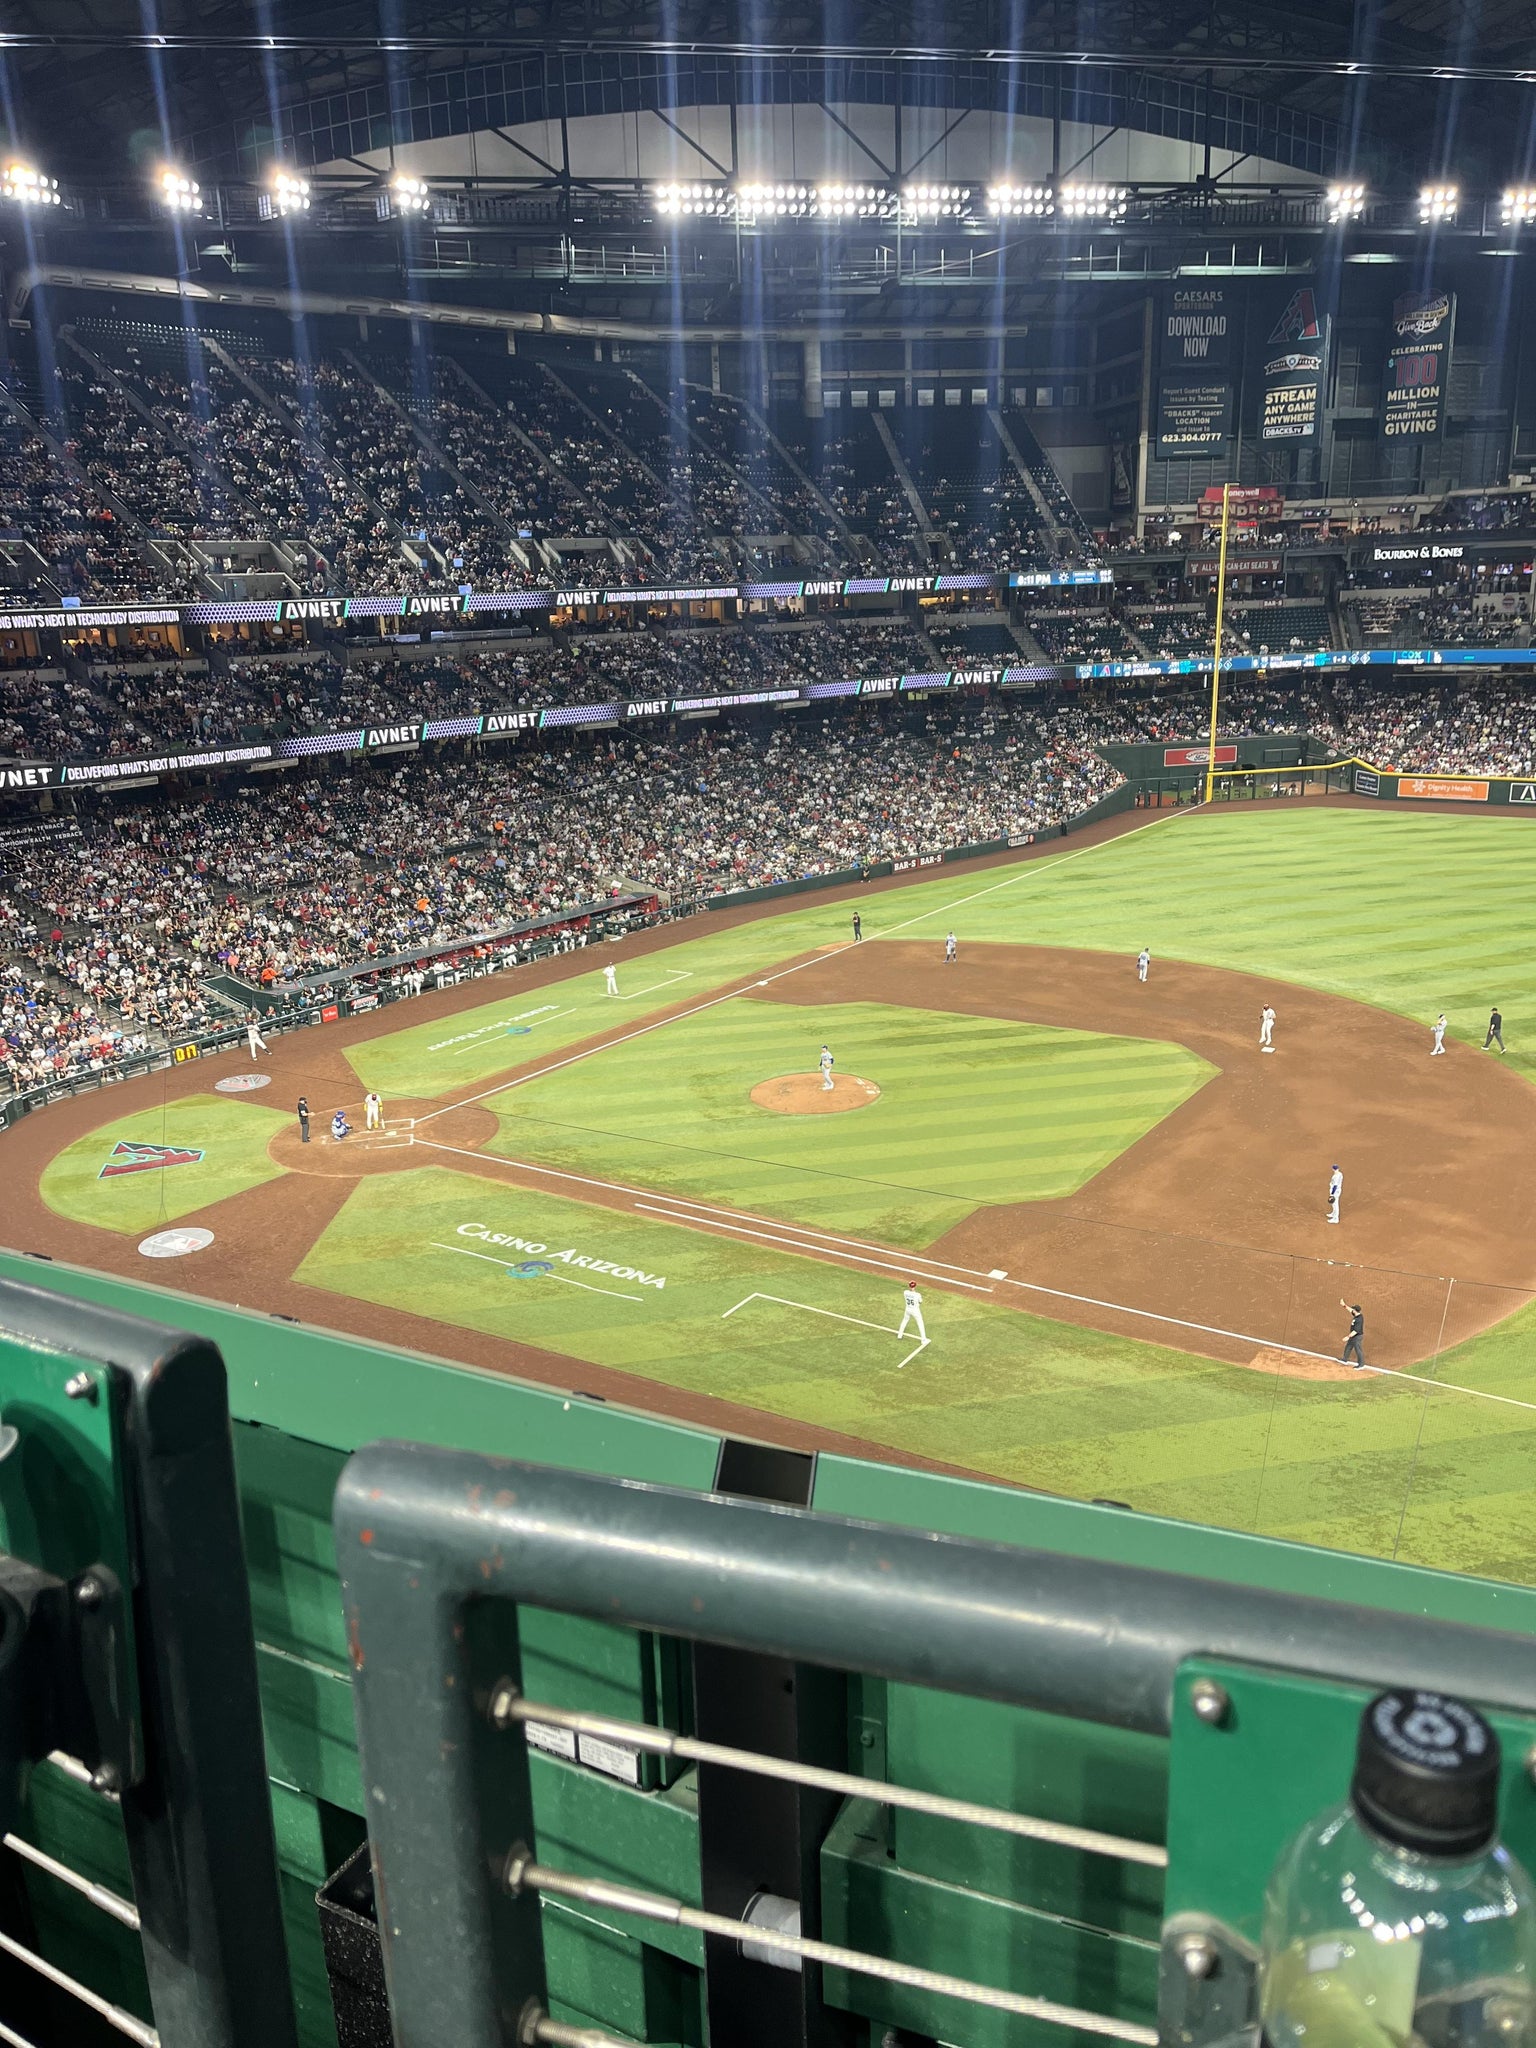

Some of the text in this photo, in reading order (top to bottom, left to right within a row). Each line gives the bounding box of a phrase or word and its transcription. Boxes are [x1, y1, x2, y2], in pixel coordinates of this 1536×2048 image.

[1174, 291, 1223, 301] CAESARS
[1168, 316, 1226, 336] DOWNLOAD
[1183, 337, 1209, 357] NOW
[1391, 343, 1443, 355] CELEBRATING
[1265, 388, 1317, 404] STREAM
[1387, 386, 1440, 401] MILLION
[1264, 401, 1316, 416] ANY GAME
[1407, 401, 1417, 410] IN
[1175, 417, 1210, 425] LOCATION
[1263, 412, 1315, 426] ANYWHERE
[1386, 409, 1437, 421] CHARITABLE
[1384, 419, 1437, 435] GIVING
[1162, 432, 1222, 442] 623.304.0777
[1223, 488, 1260, 497] oneywell
[1201, 503, 1280, 516] SANDLOT
[1374, 546, 1464, 561] BOURBON & BONES
[1251, 560, 1269, 569] SEATS
[891, 577, 934, 591] AVNET
[1017, 573, 1051, 586] 8:11 PM
[805, 581, 843, 595] AVNET
[410, 596, 462, 613] AVNET
[557, 592, 600, 605] AVNET
[286, 602, 342, 619] AVNET
[12, 614, 45, 628] WHAT'S
[45, 613, 66, 627] NEXT
[66, 613, 77, 626] IN
[77, 611, 128, 625] TECHNOLOGY
[128, 610, 180, 624] DISTRIBUTION
[1401, 651, 1422, 659] COX
[953, 670, 1001, 685] AVNET
[862, 677, 899, 693] AVNET
[627, 701, 669, 717] AVNET
[488, 712, 538, 731] AVNET
[369, 725, 419, 746] AVNET
[67, 763, 119, 781] DELIVERING
[119, 760, 150, 775] WHAT'S
[150, 758, 169, 772] NEXT
[169, 756, 178, 769] IN
[178, 751, 225, 768] TECHNOLOGY
[225, 745, 272, 762] DISTRIBUTION
[1427, 783, 1473, 793] Dignity Health
[54, 830, 83, 840] TERRACE
[894, 859, 917, 872] BAR-S
[920, 854, 942, 866] BAR-S
[456, 1223, 666, 1289] CASINO ARIZONA
